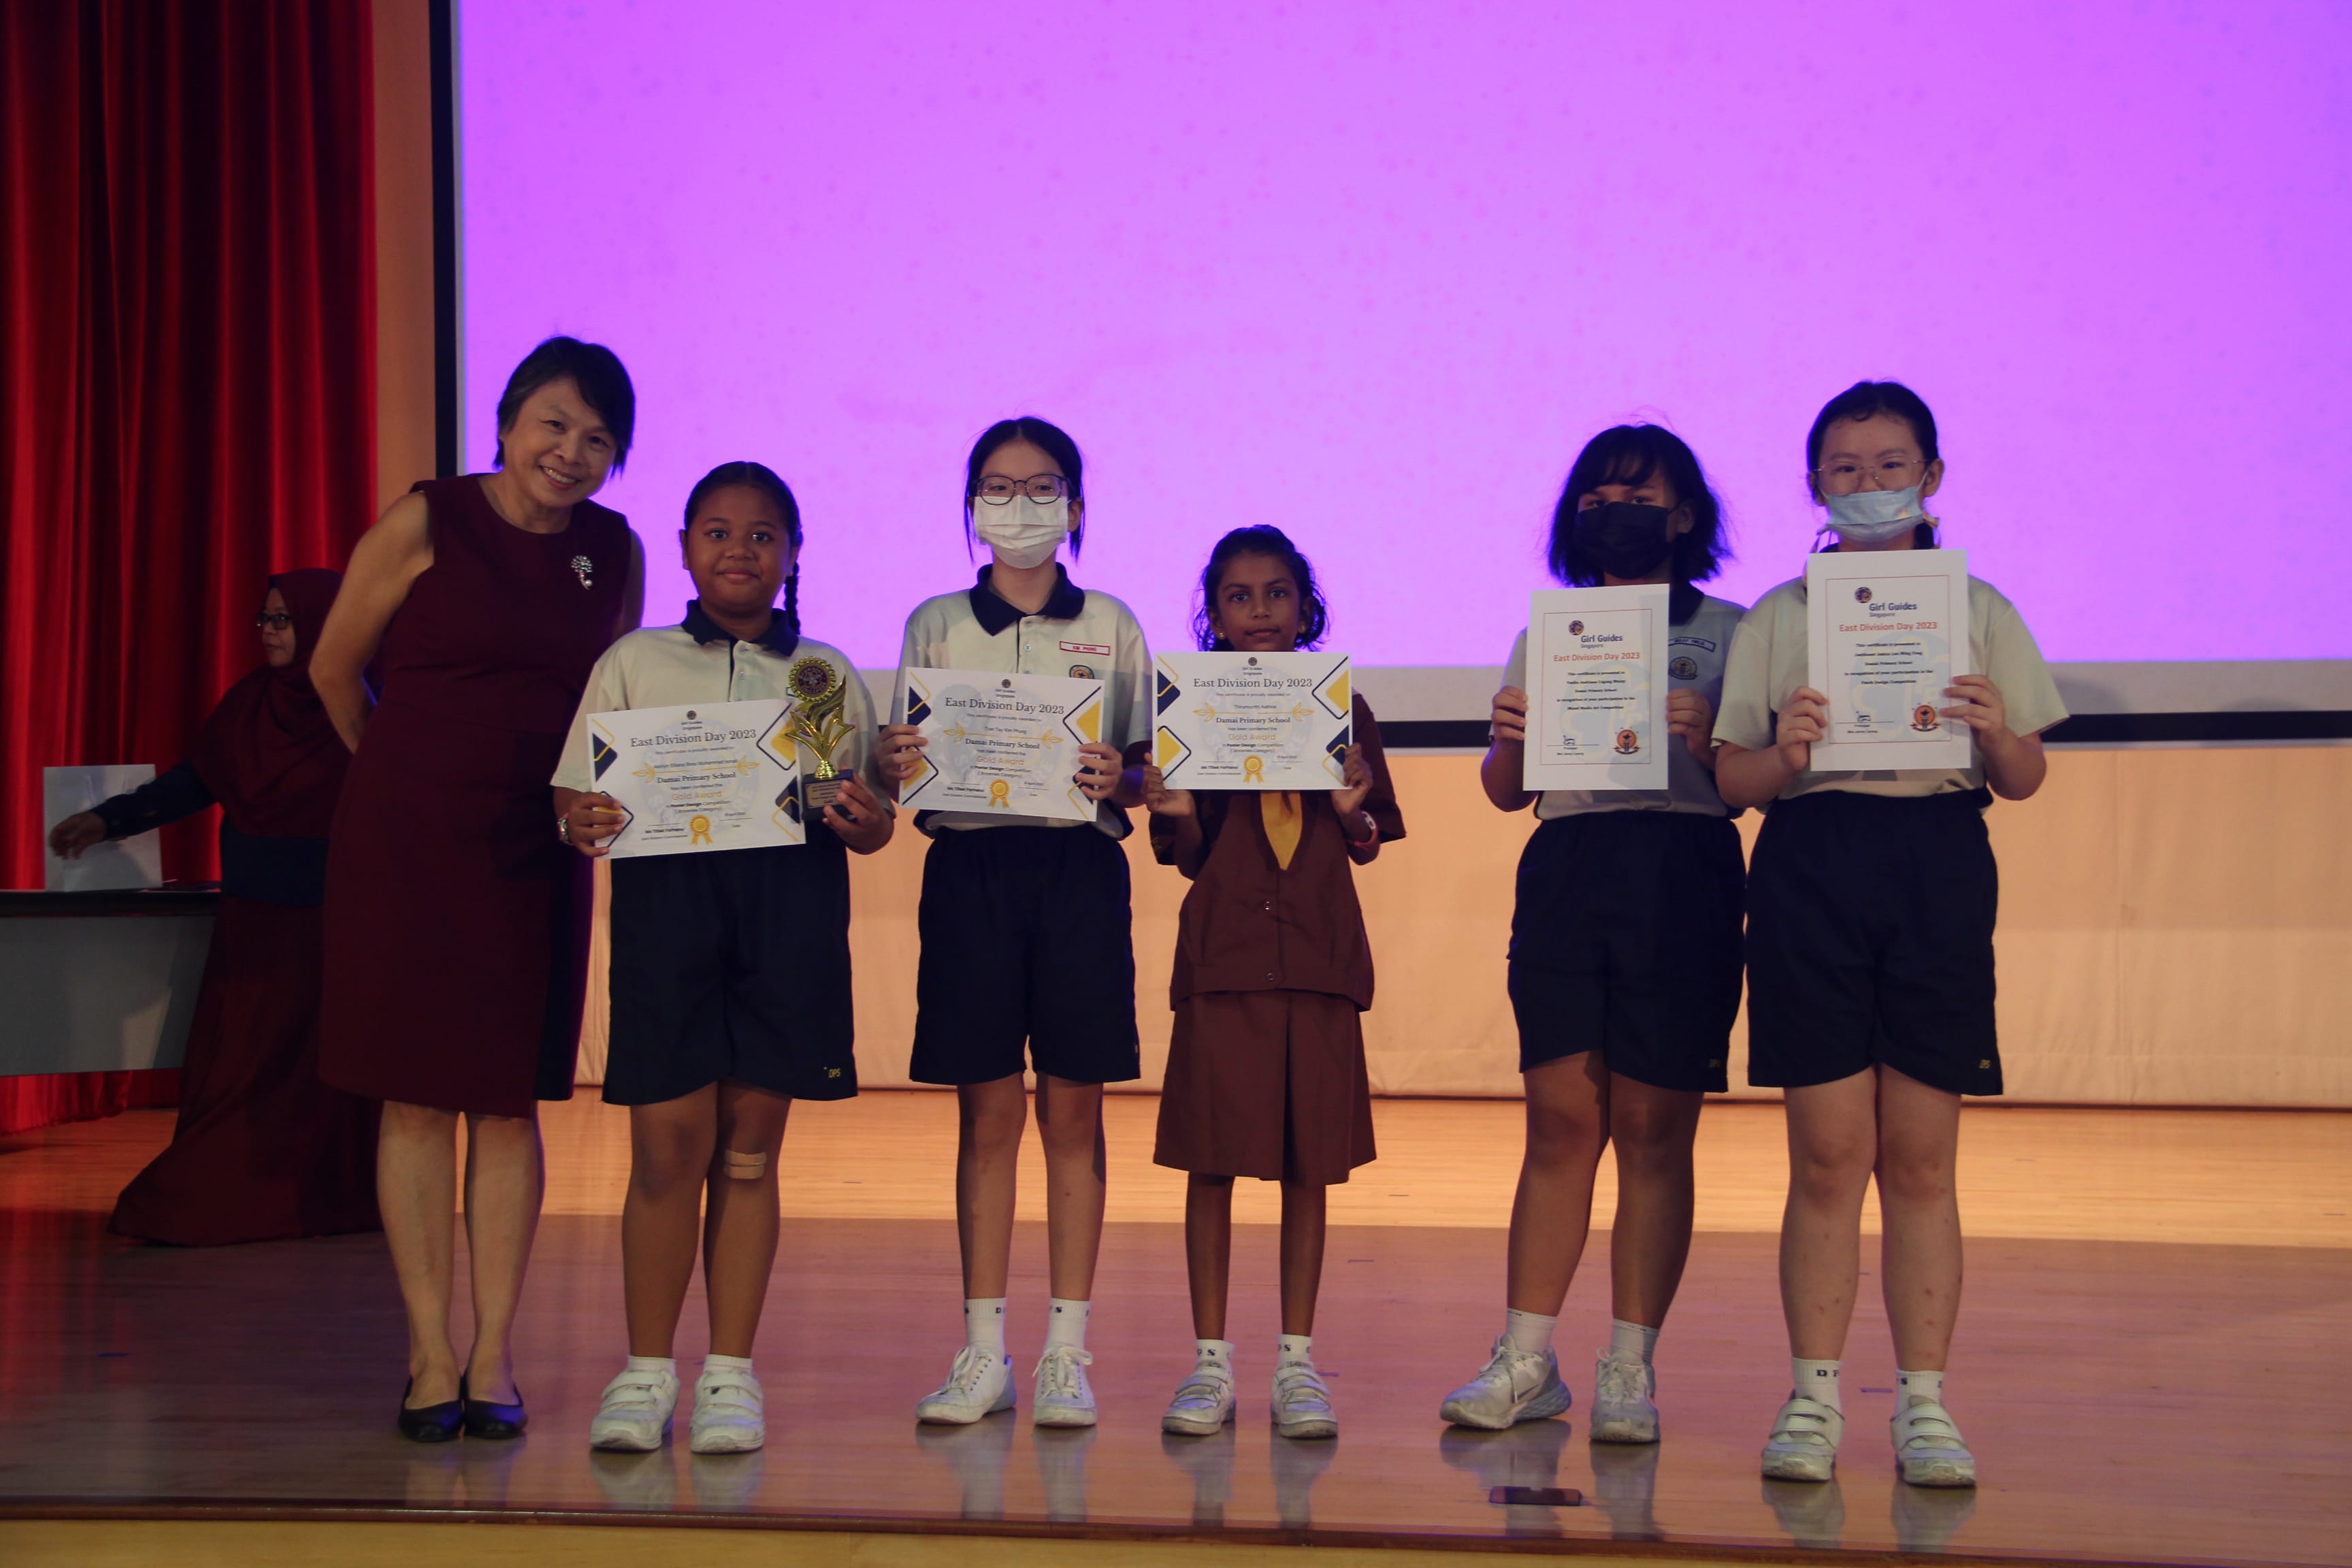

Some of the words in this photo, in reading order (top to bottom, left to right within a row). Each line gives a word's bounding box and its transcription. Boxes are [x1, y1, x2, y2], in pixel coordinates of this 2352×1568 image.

[1897, 623, 1914, 631] Day
[1263, 679, 1284, 689] Day
[945, 698, 966, 707] East
[969, 700, 1013, 710] Division
[1015, 703, 1036, 714] Day
[1039, 704, 1064, 714] 2023
[631, 737, 653, 747] East
[656, 734, 701, 745] Division
[705, 732, 727, 743] Day
[730, 730, 757, 740] 2023
[989, 740, 1016, 749] Primary
[683, 774, 710, 783] Primary
